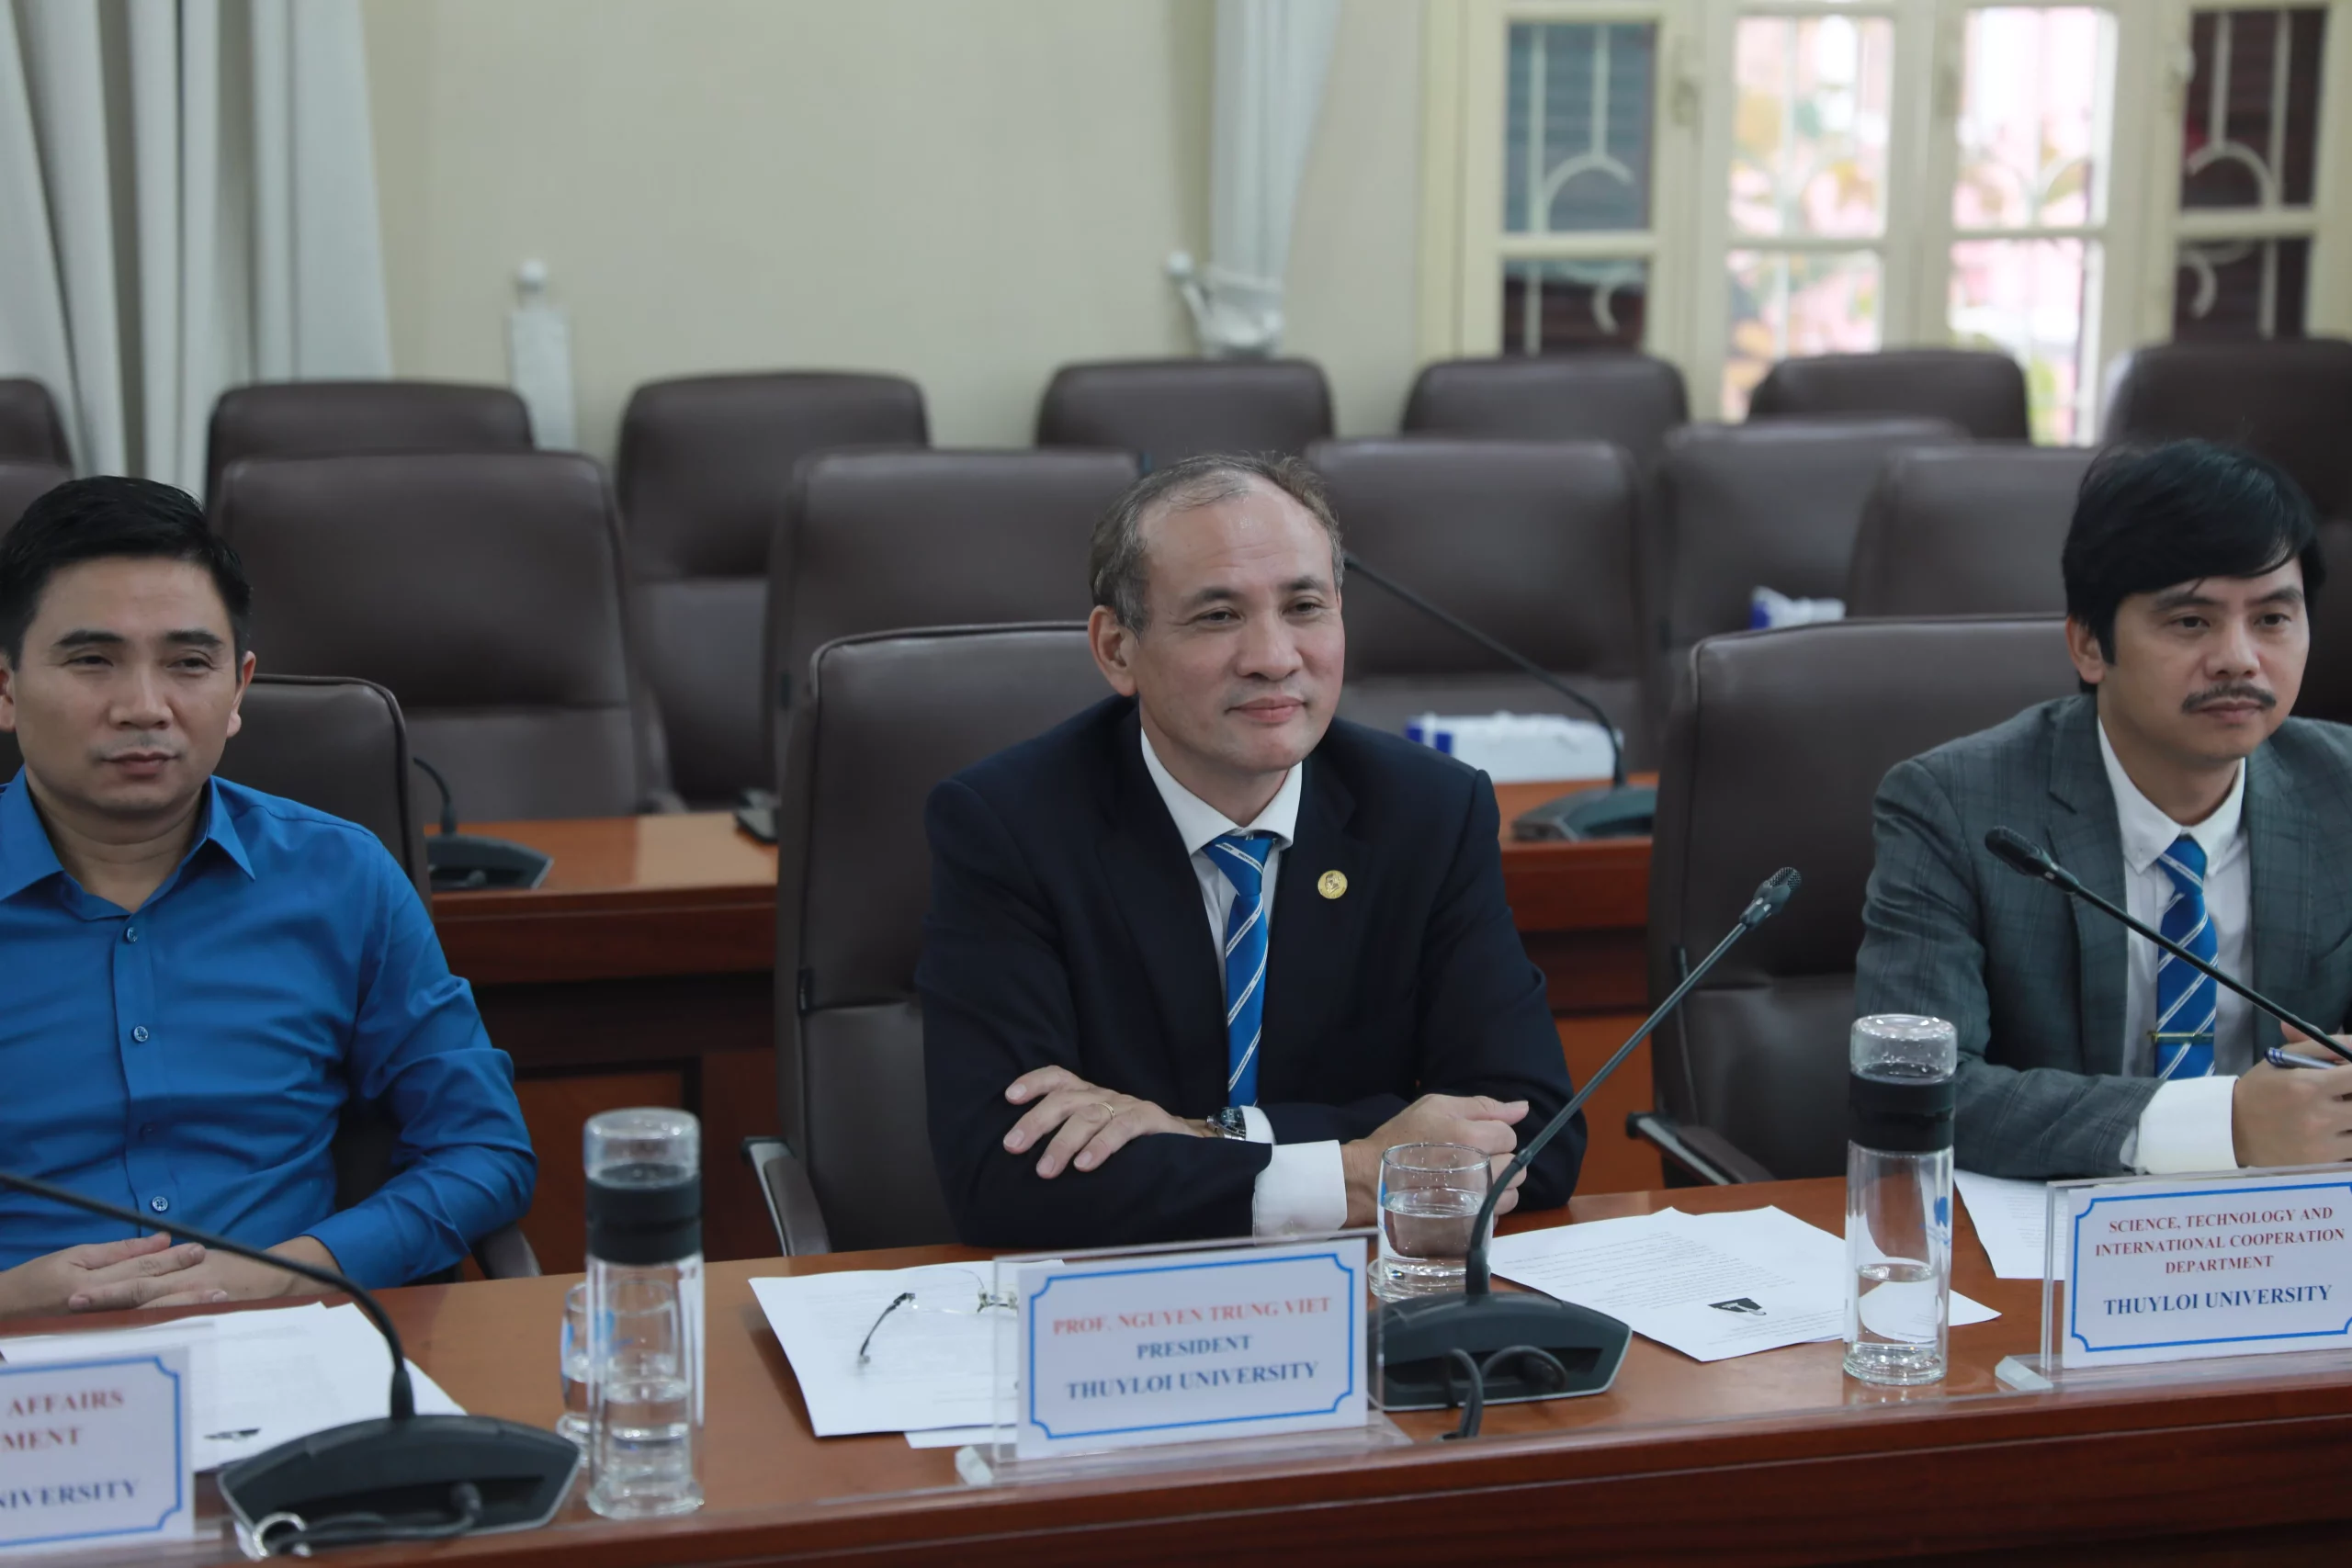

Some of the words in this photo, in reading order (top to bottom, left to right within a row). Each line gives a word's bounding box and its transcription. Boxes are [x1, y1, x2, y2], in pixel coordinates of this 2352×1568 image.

[2109, 1217, 2181, 1233] SCIENCE,
[2185, 1209, 2296, 1227] TECHNOLOGY
[2300, 1207, 2333, 1221] AND
[2096, 1236, 2225, 1257] INTERNATIONAL
[2230, 1228, 2345, 1247] COOPERATION
[2165, 1255, 2274, 1274] DEPARTMENT
[1117, 1308, 1203, 1329] NGUYEN
[1209, 1303, 1279, 1321] TRUNG
[1284, 1296, 1331, 1314] VIET
[2103, 1293, 2198, 1315] THUYLOI
[2205, 1284, 2332, 1309] UNIVERSITY
[1136, 1334, 1252, 1359] PRESIDENT
[1067, 1374, 1172, 1400] THUYLOI
[1180, 1360, 1318, 1390] UNIVERSITY
[7, 1389, 124, 1416] AFFAIRS
